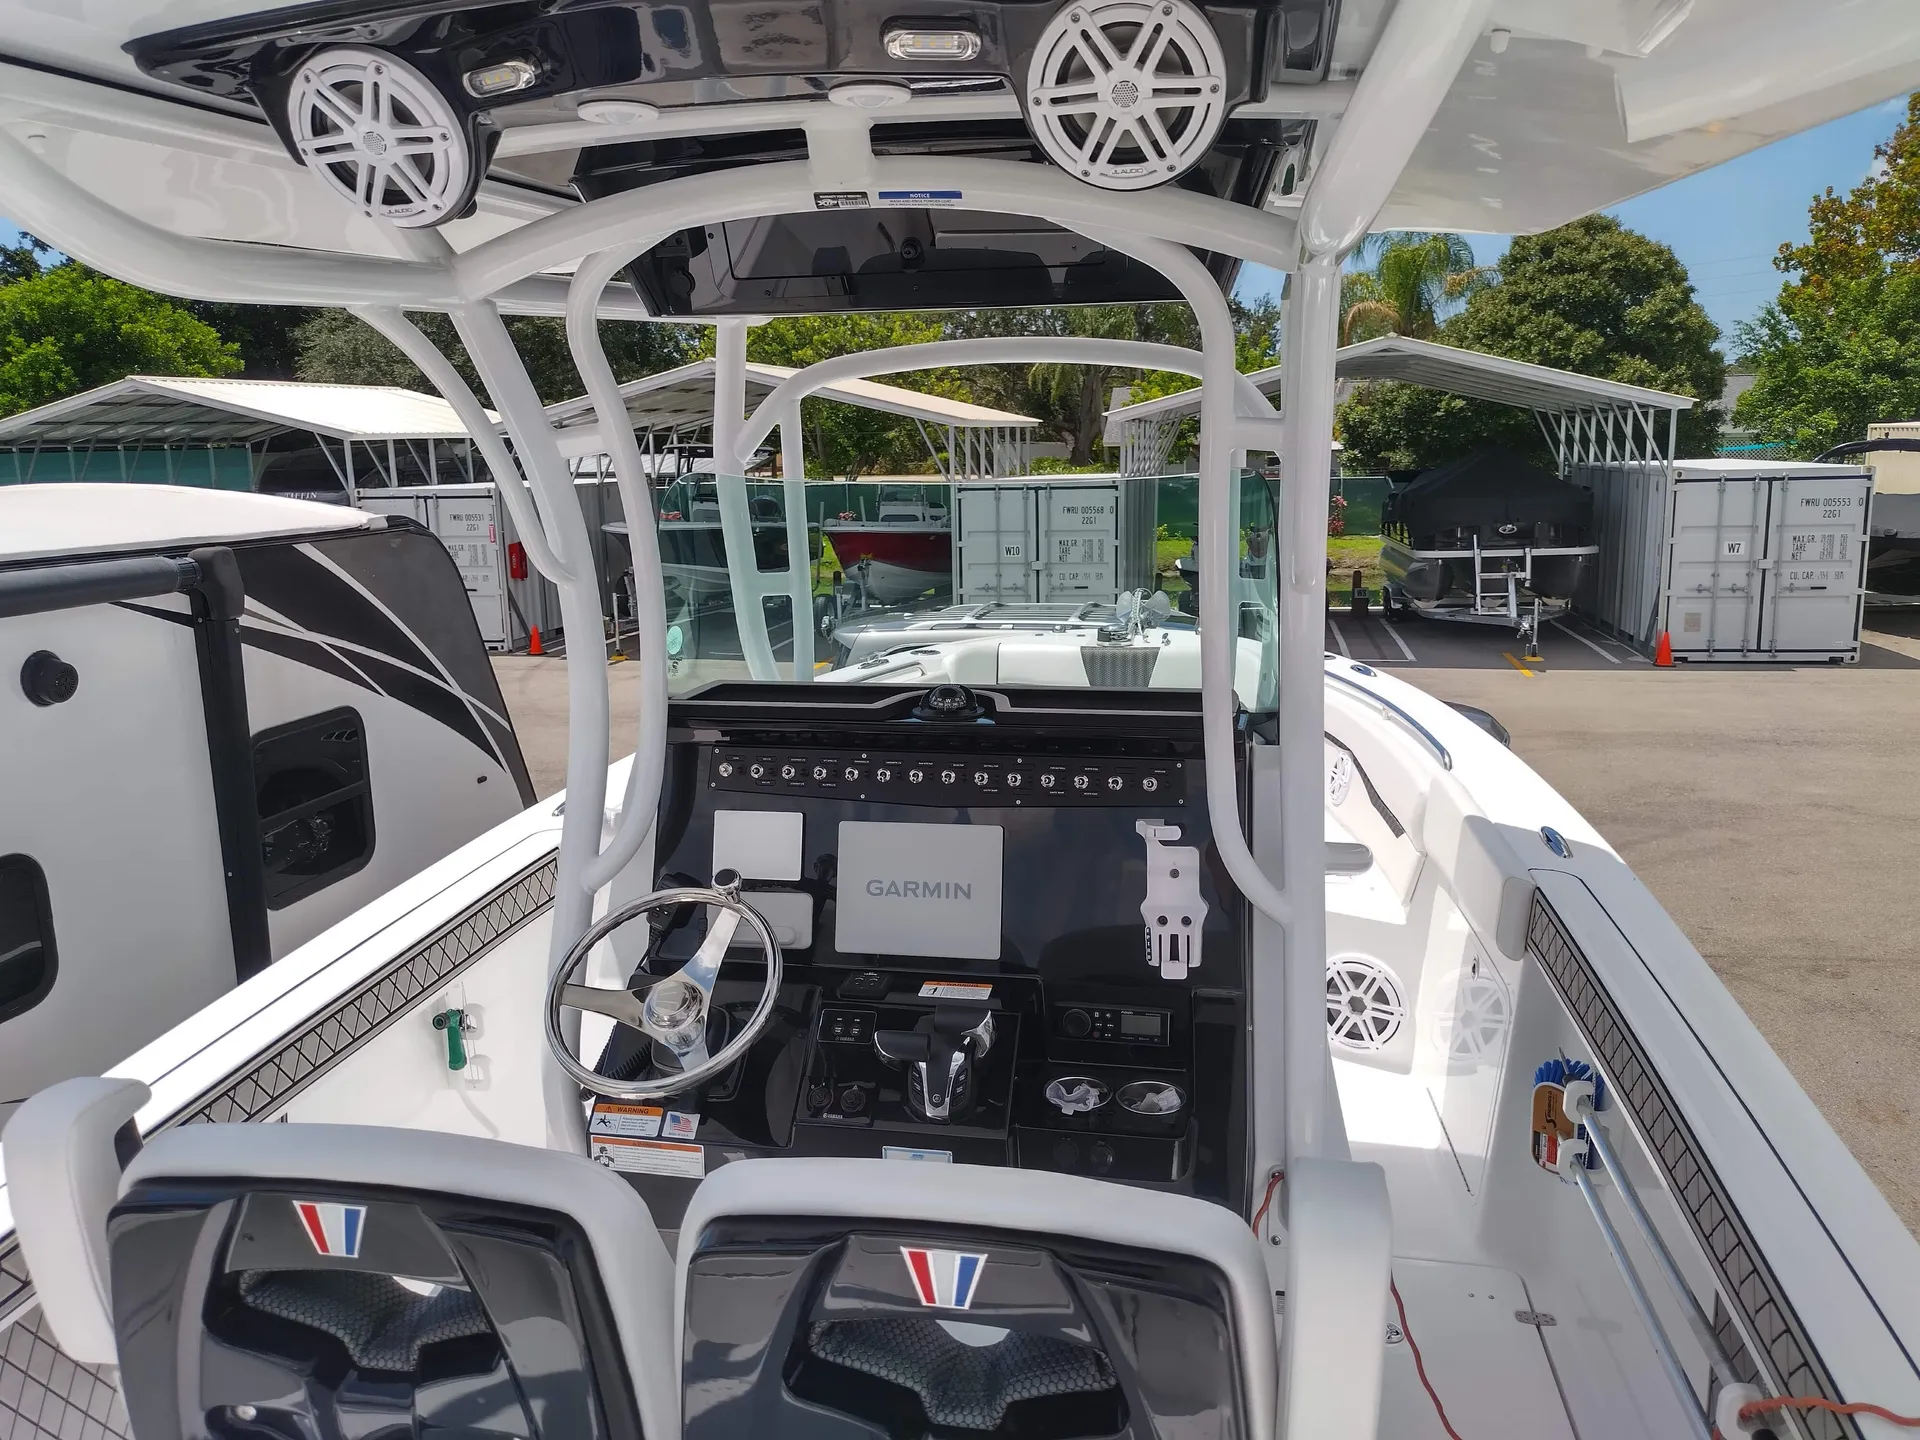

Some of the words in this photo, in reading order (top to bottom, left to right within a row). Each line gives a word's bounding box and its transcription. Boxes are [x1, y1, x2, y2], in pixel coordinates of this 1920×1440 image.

[1801, 498, 1820, 507] FWRU
[1823, 498, 1851, 507] 005553
[1859, 498, 1864, 506] 0
[1063, 506, 1079, 514] FWRU
[1081, 506, 1105, 514] 005568
[1110, 506, 1114, 514] 0
[1823, 510, 1841, 518] 22G1
[1005, 546, 1020, 555] W10
[1060, 547, 1071, 555] TARE
[1728, 543, 1741, 553] W7
[1793, 543, 1806, 552] TARE
[1791, 552, 1802, 560] NET
[1790, 571, 1799, 580] CU.
[1802, 571, 1814, 580] CAP.
[866, 880, 971, 899] GARMIN
[617, 1106, 649, 1114] WARNING
